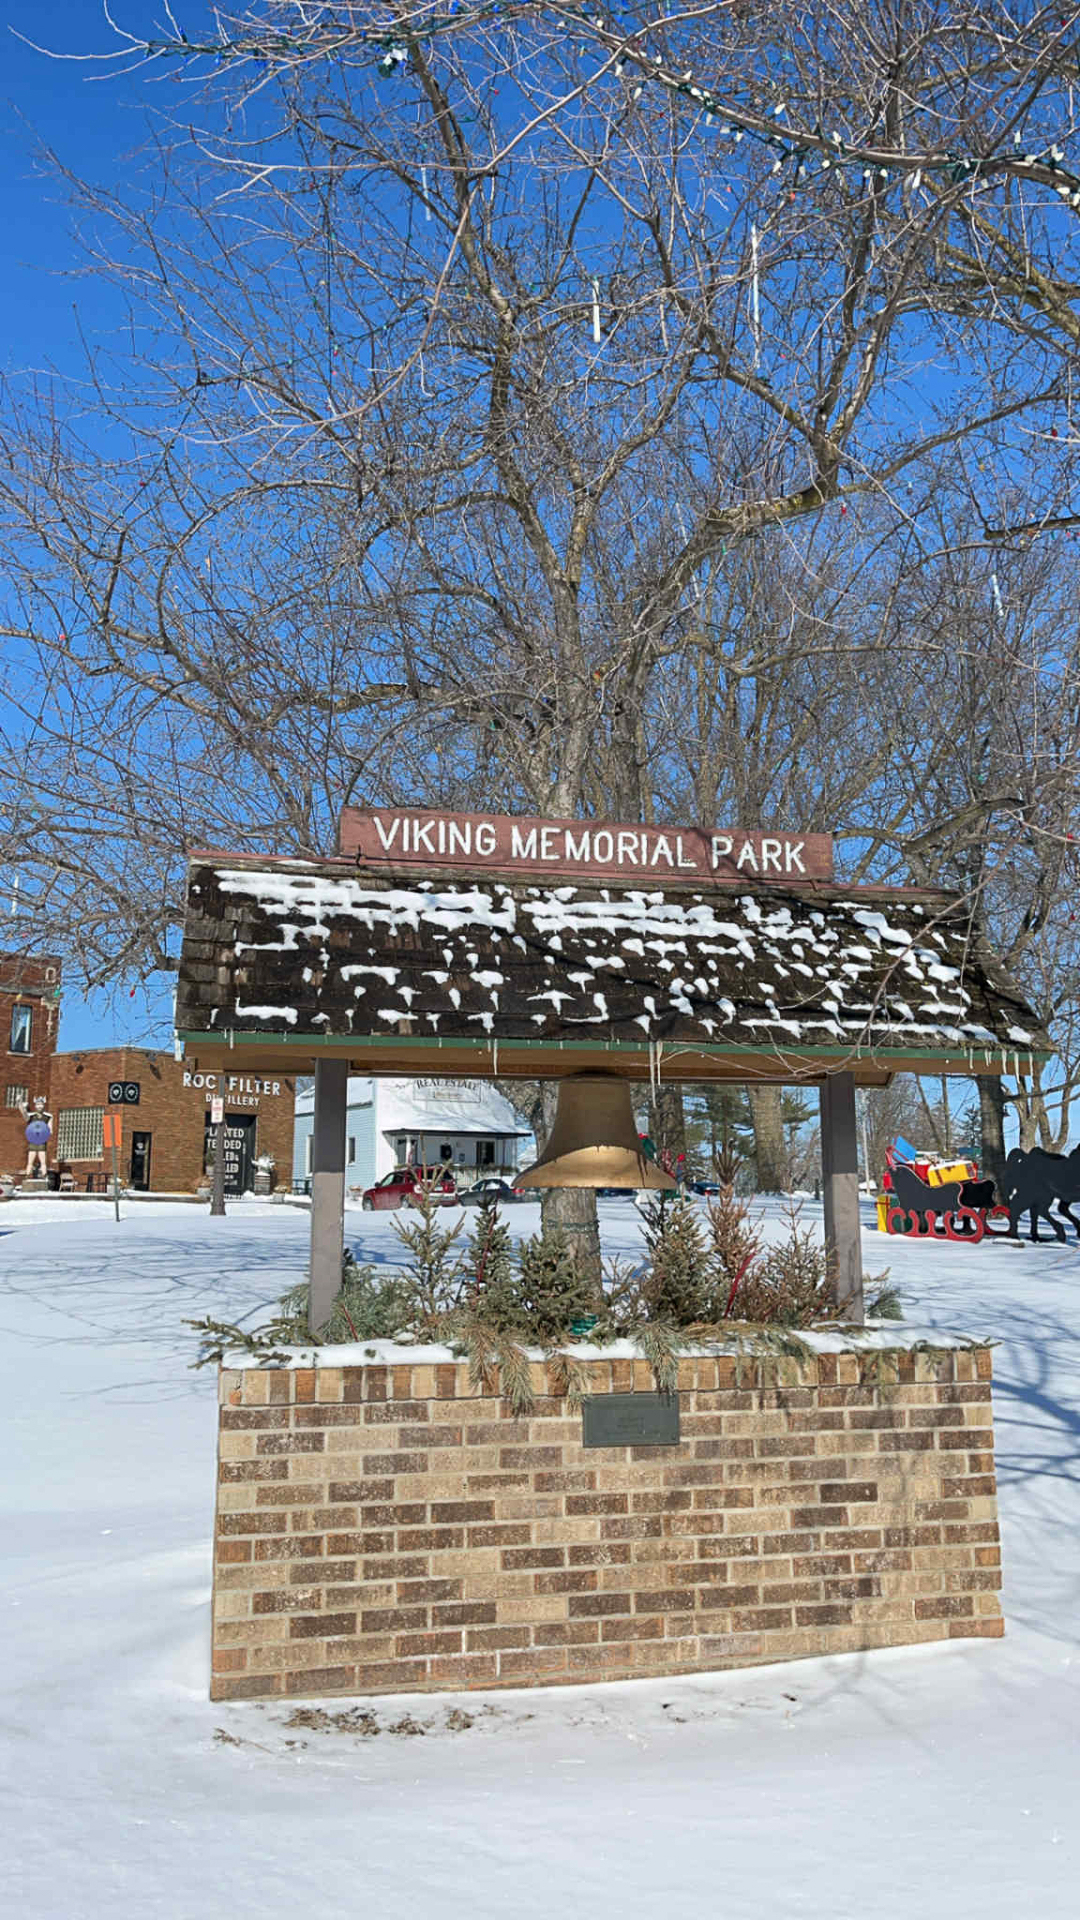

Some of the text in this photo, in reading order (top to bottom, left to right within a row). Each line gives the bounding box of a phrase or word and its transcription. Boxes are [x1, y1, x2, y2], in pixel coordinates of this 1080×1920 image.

[374, 816, 807, 874] VIKING MEMORIAL PARK
[182, 1072, 281, 1095] ROC FILTER
[207, 1139, 242, 1150] TEDED
